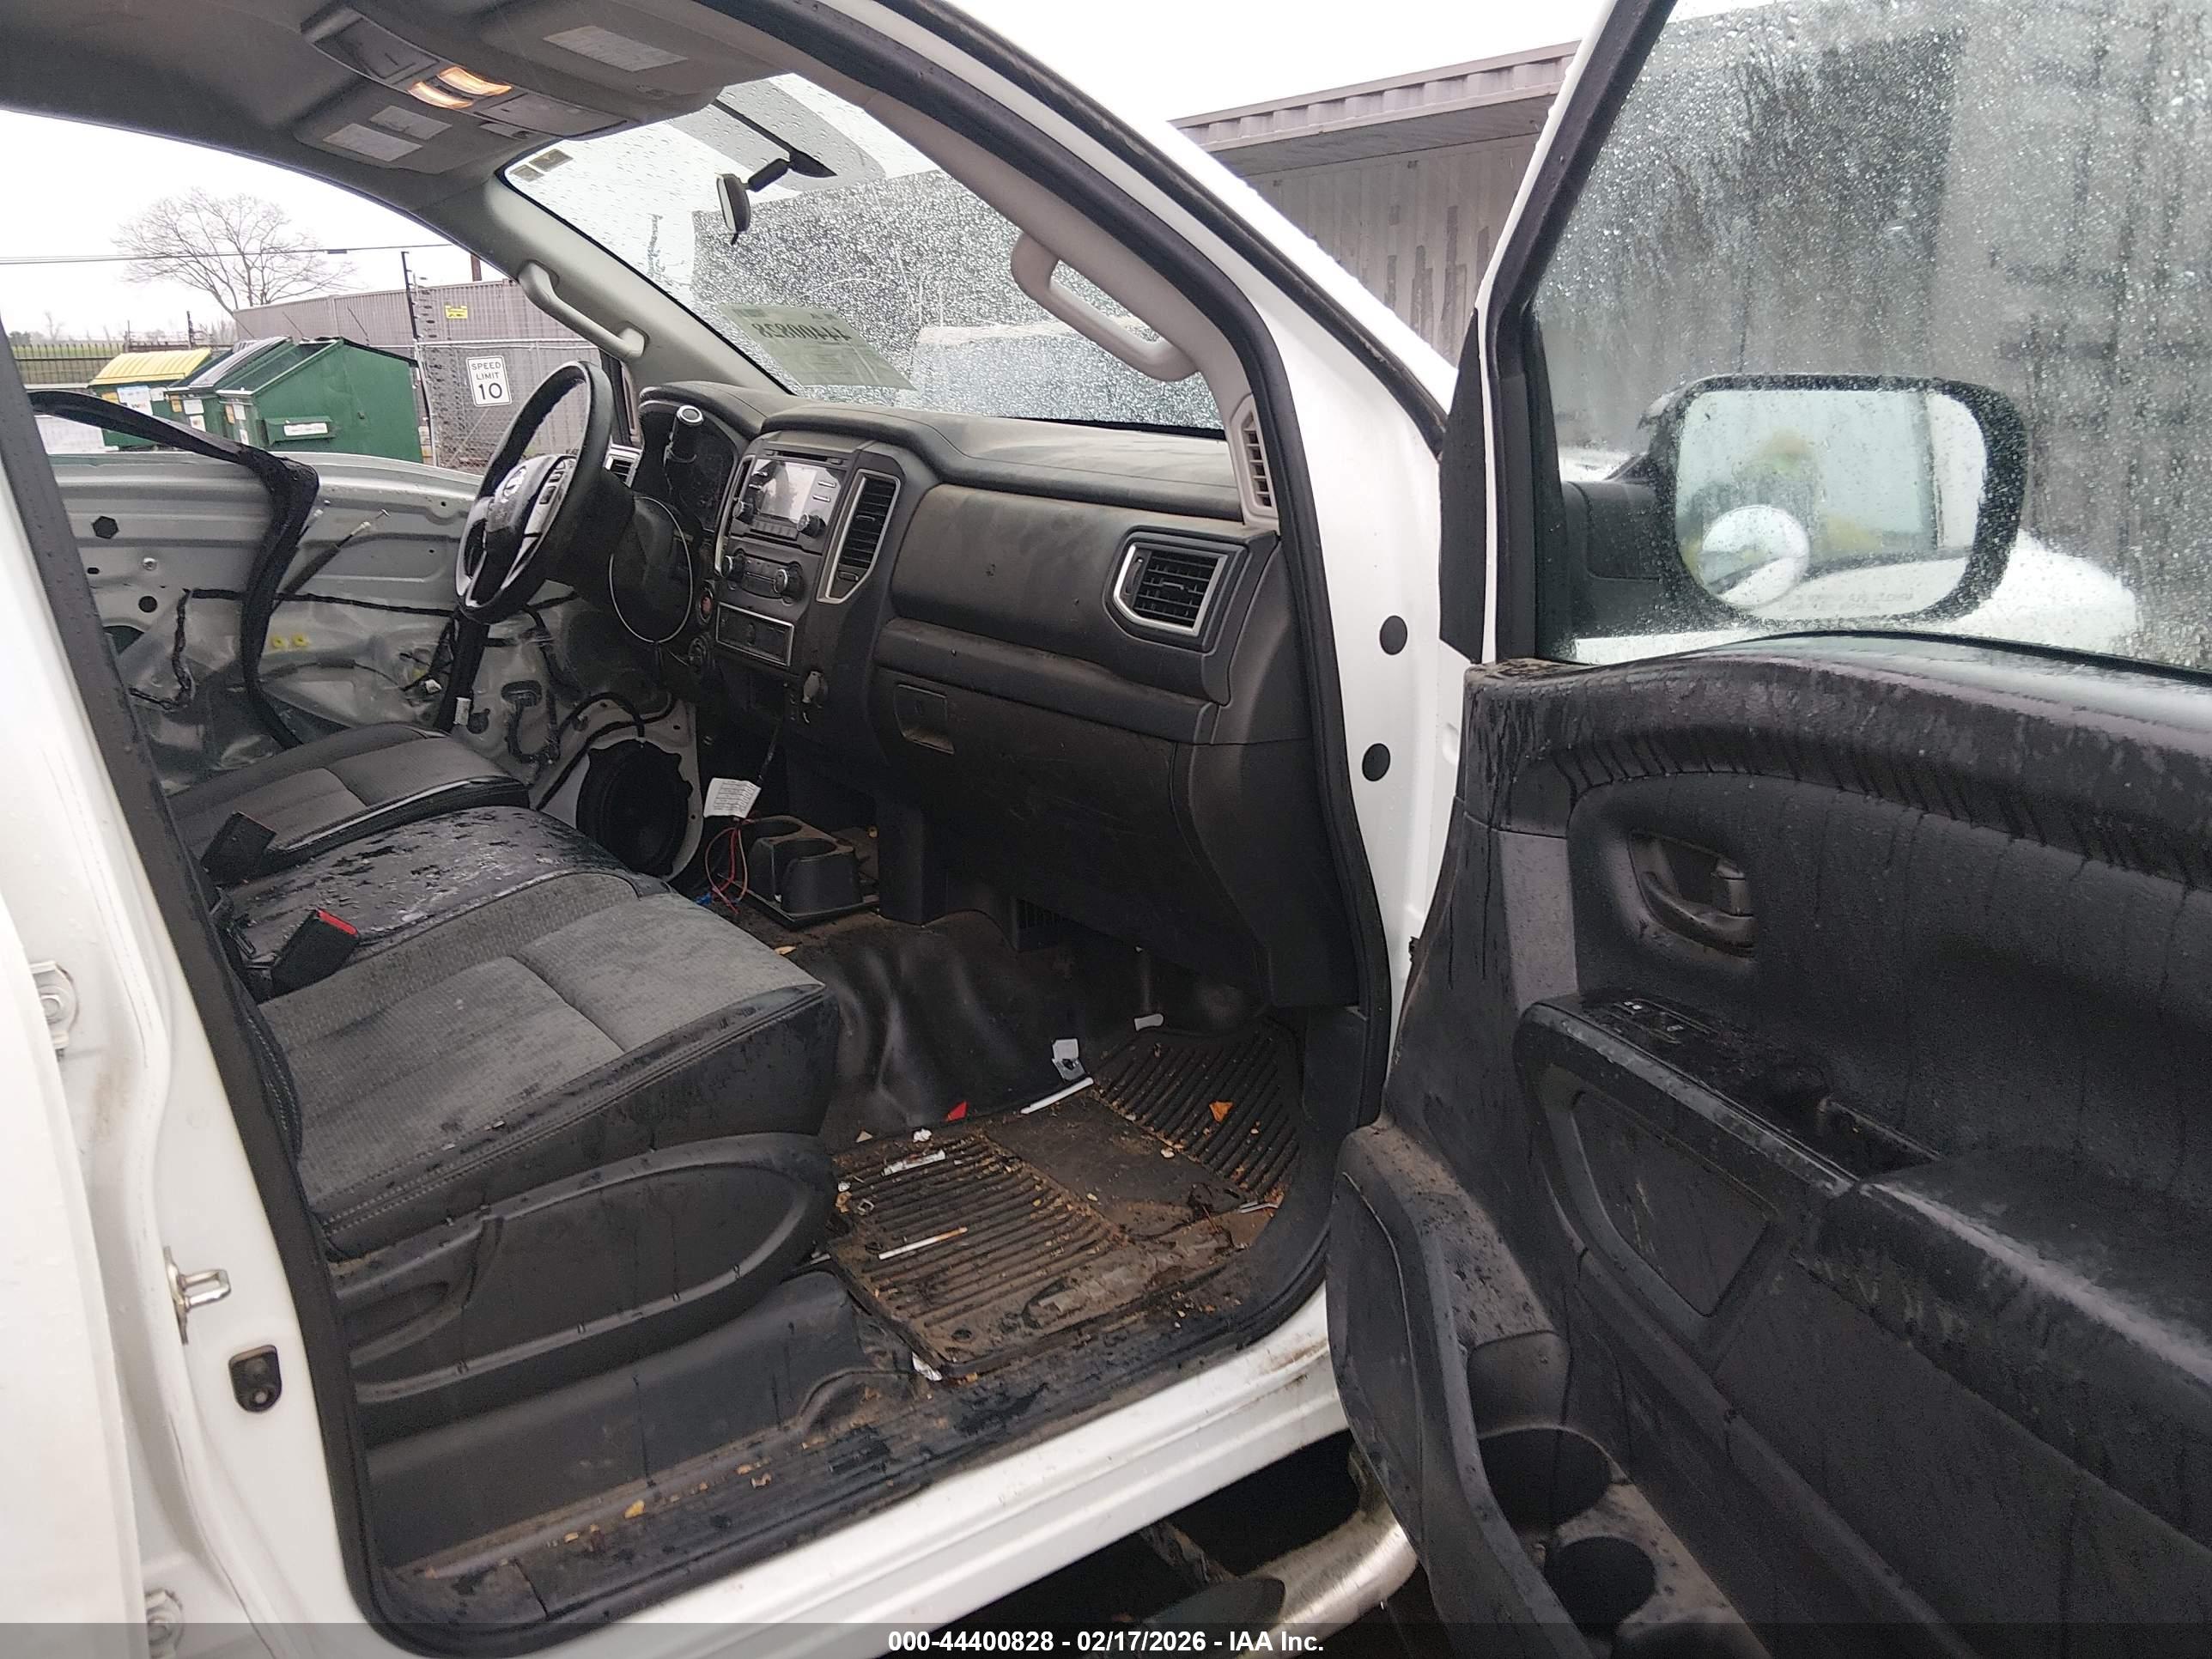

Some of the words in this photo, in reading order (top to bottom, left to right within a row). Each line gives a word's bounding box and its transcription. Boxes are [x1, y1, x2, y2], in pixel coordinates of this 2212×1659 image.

[471, 362, 501, 371] SPEED
[476, 372, 500, 380] LIMIT
[478, 382, 502, 400] 10
